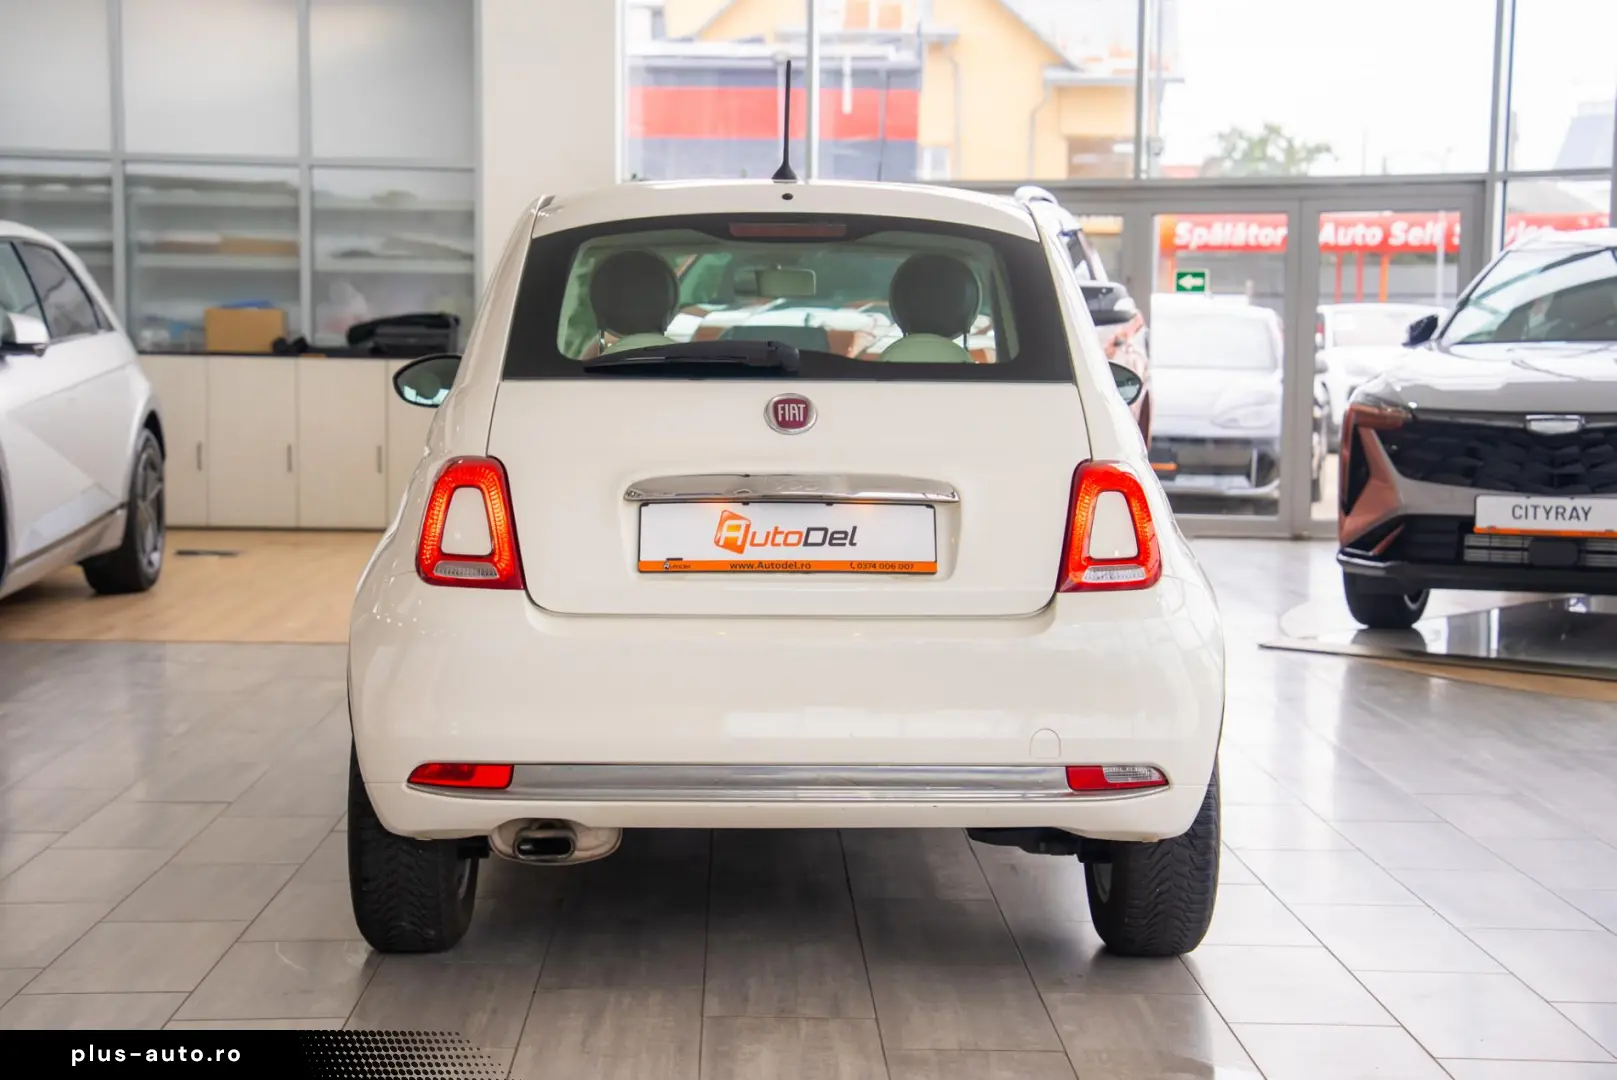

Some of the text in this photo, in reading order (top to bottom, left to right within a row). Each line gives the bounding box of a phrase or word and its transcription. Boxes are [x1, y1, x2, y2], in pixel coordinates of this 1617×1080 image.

[1319, 221, 1384, 246] Auto
[778, 403, 806, 422] FIAT
[1511, 504, 1592, 522] CITYRAY
[716, 517, 858, 548] AutoDel
[729, 560, 812, 570] www.Autodel.ro
[856, 562, 877, 570] 0374
[879, 562, 896, 570] 006
